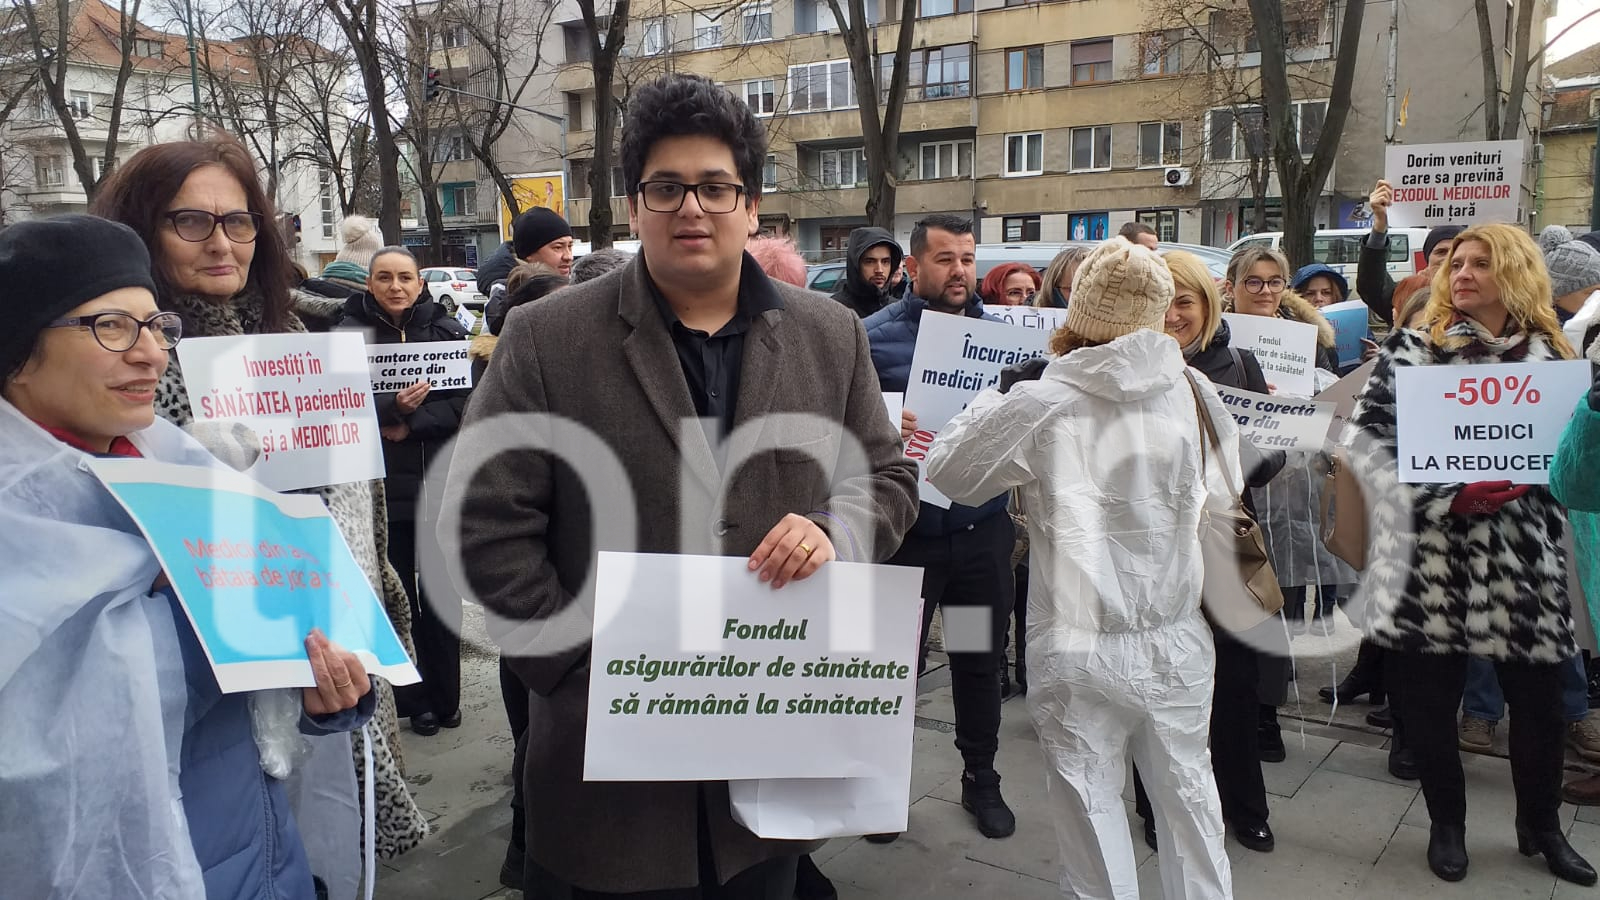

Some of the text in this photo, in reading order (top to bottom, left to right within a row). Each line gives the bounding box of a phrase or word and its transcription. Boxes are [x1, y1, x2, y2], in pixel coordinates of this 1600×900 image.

[1407, 150, 1502, 168] Dorim venituri
[1402, 167, 1504, 186] care sa prevină
[1393, 185, 1511, 202] EXODUL MEDICILOR
[1425, 202, 1476, 222] din țară
[1258, 335, 1281, 346] Fondul
[367, 349, 468, 366] nanțare corectă
[1269, 350, 1278, 358] de
[1280, 351, 1307, 363] sănătate
[243, 351, 322, 383] Investiți în
[381, 363, 446, 377] ca cea din
[1267, 361, 1274, 370] la
[1275, 362, 1305, 376] sănătate!
[441, 376, 466, 387] stat
[921, 368, 984, 391] medicii
[1444, 375, 1541, 406] -50%
[201, 387, 366, 419] SĂNĂTATEA pacienților
[1255, 400, 1316, 417] corectă
[1253, 415, 1281, 430] din
[1264, 434, 1299, 447] stat
[1454, 424, 1533, 440] MEDICI
[263, 422, 360, 461] și a MEDICILOR
[905, 430, 938, 461] STO
[1411, 455, 1440, 470] LA
[260, 565, 284, 587] de
[722, 619, 808, 641] Fondul
[606, 654, 909, 682] asigurărilor de sănătate
[609, 692, 902, 715] să rămână la sănătate!
